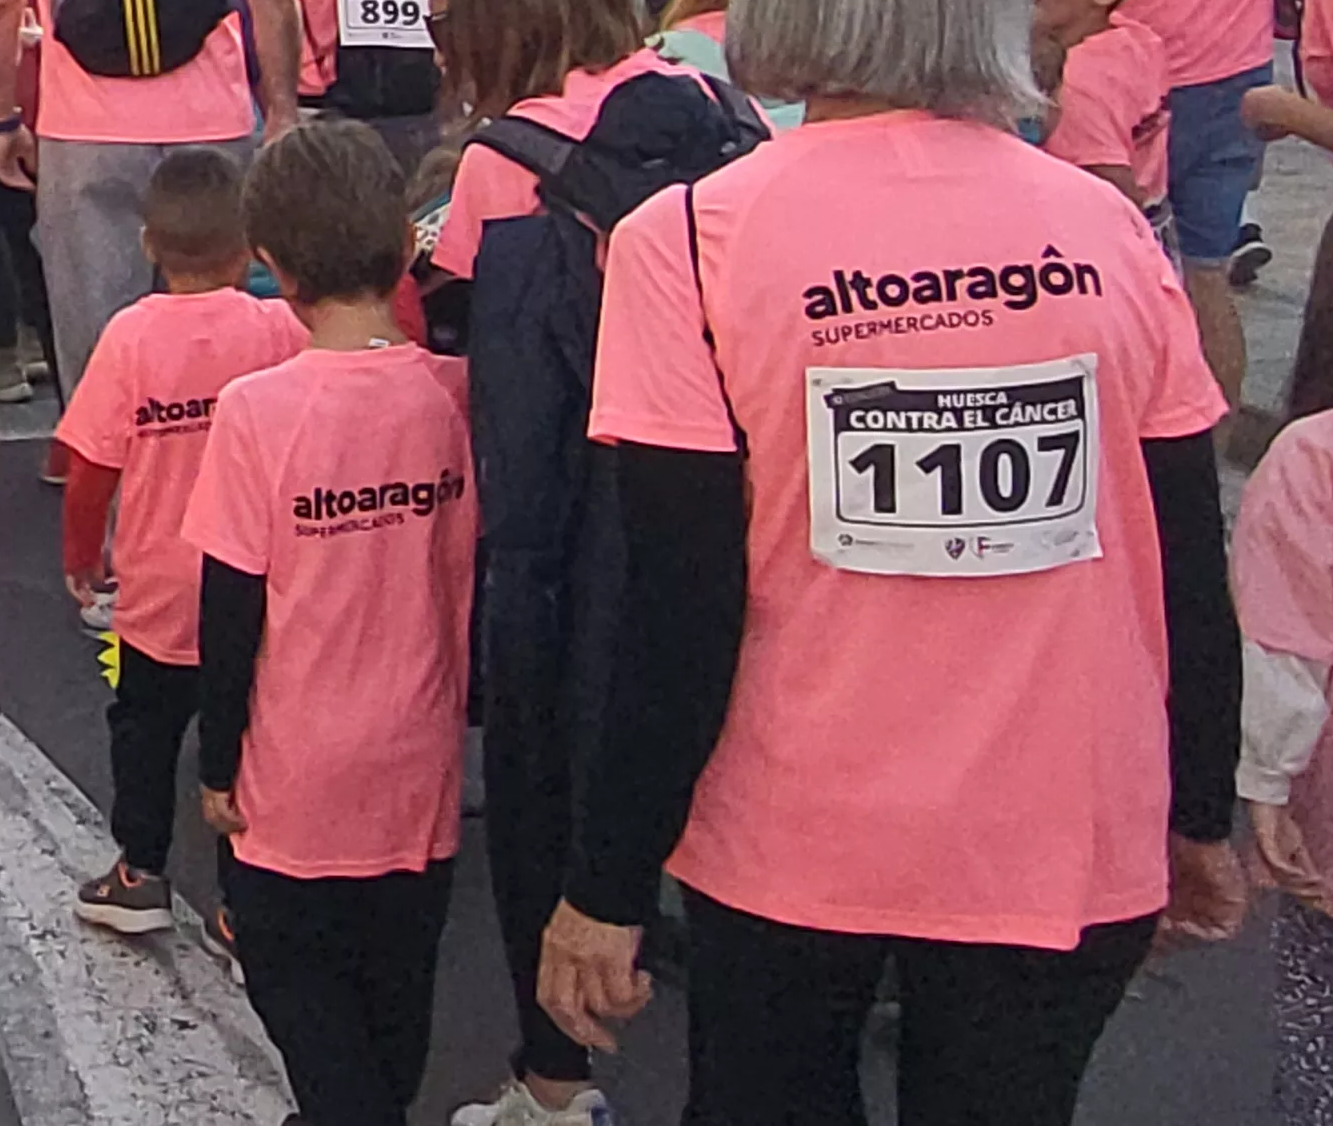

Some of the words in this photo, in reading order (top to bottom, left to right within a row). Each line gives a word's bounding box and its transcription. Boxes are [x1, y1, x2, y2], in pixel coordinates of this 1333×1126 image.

[361, 0, 420, 26] 899
[811, 309, 995, 347] SUPERMERCADOS
[849, 409, 957, 430] CONTRA
[963, 406, 990, 428] EL
[995, 399, 1079, 426] CÁNCER
[938, 391, 1008, 408] HUESCA
[848, 430, 1080, 516] 1107
